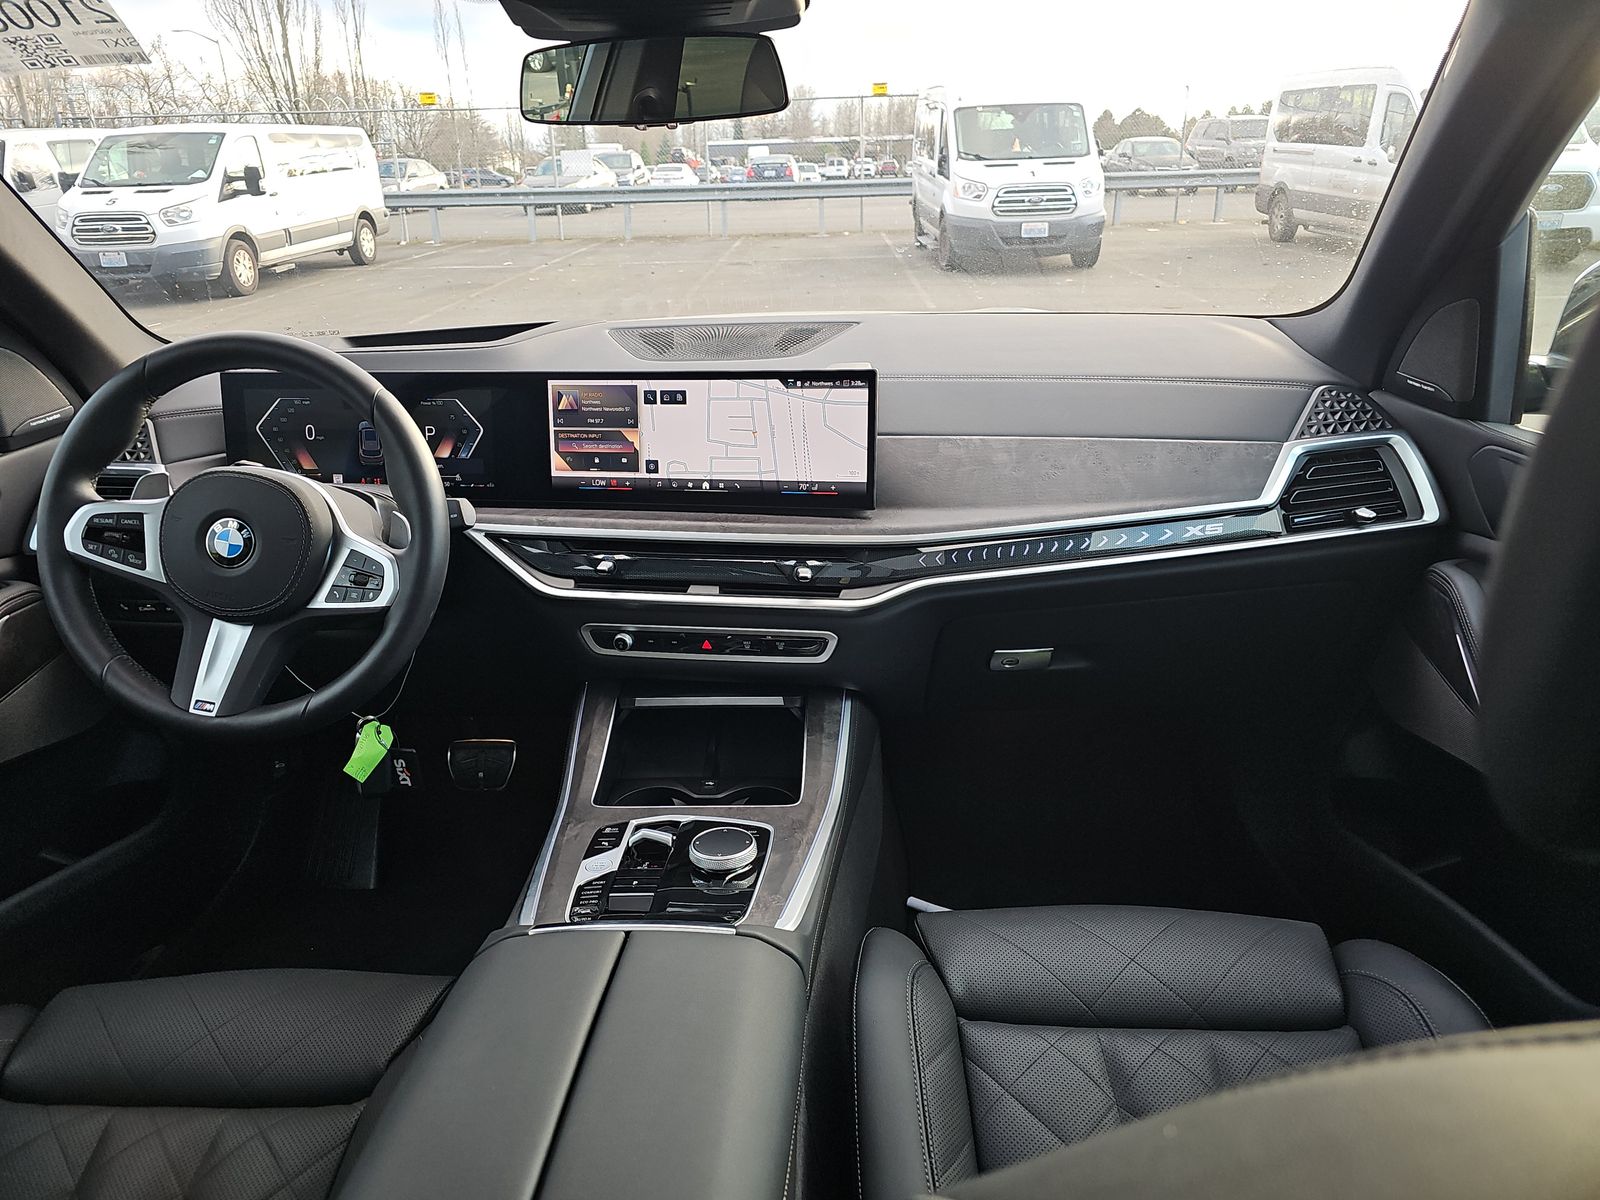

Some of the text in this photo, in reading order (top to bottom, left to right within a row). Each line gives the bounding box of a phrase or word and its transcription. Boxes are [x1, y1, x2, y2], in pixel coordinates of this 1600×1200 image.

[305, 424, 315, 440] 0
[425, 425, 436, 441] P
[213, 520, 251, 539] BMW
[1182, 523, 1224, 538] X5
